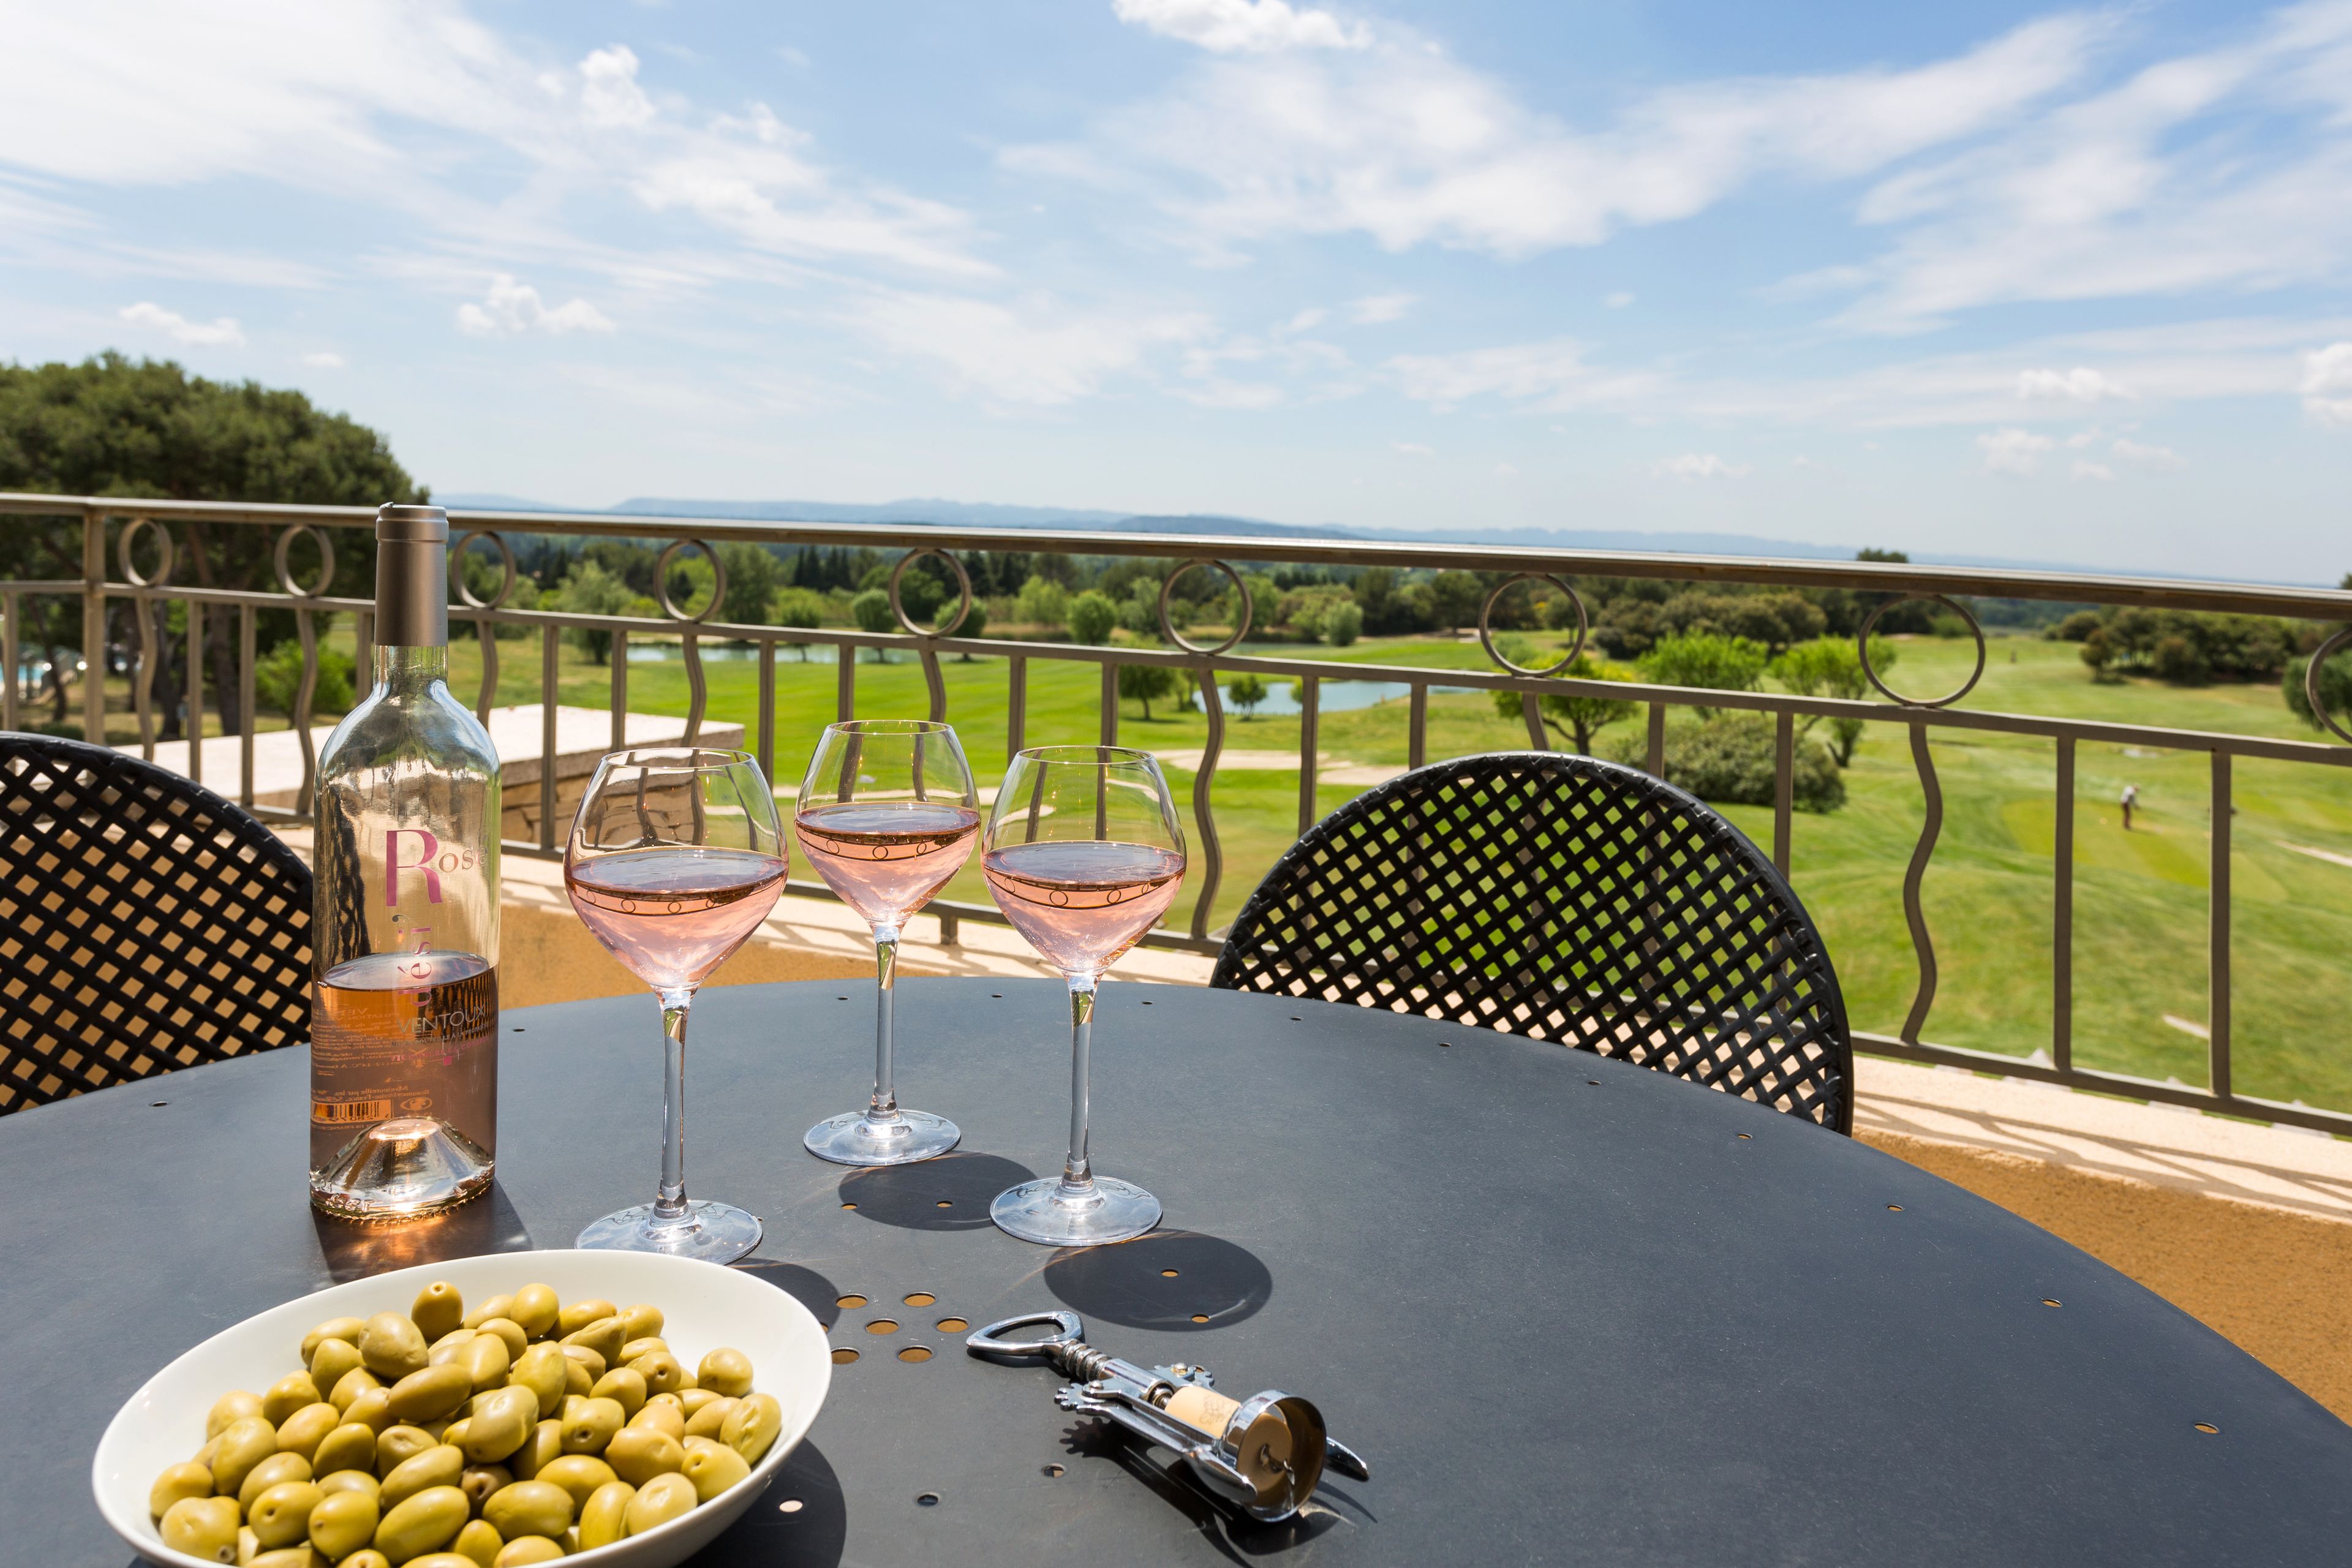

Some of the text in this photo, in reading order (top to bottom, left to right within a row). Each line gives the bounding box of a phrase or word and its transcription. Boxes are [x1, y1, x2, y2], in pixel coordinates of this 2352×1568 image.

[386, 829, 488, 907] Rosé
[396, 1004, 486, 1034] VENTOUX
[415, 1034, 451, 1044] BOUTEILLE
